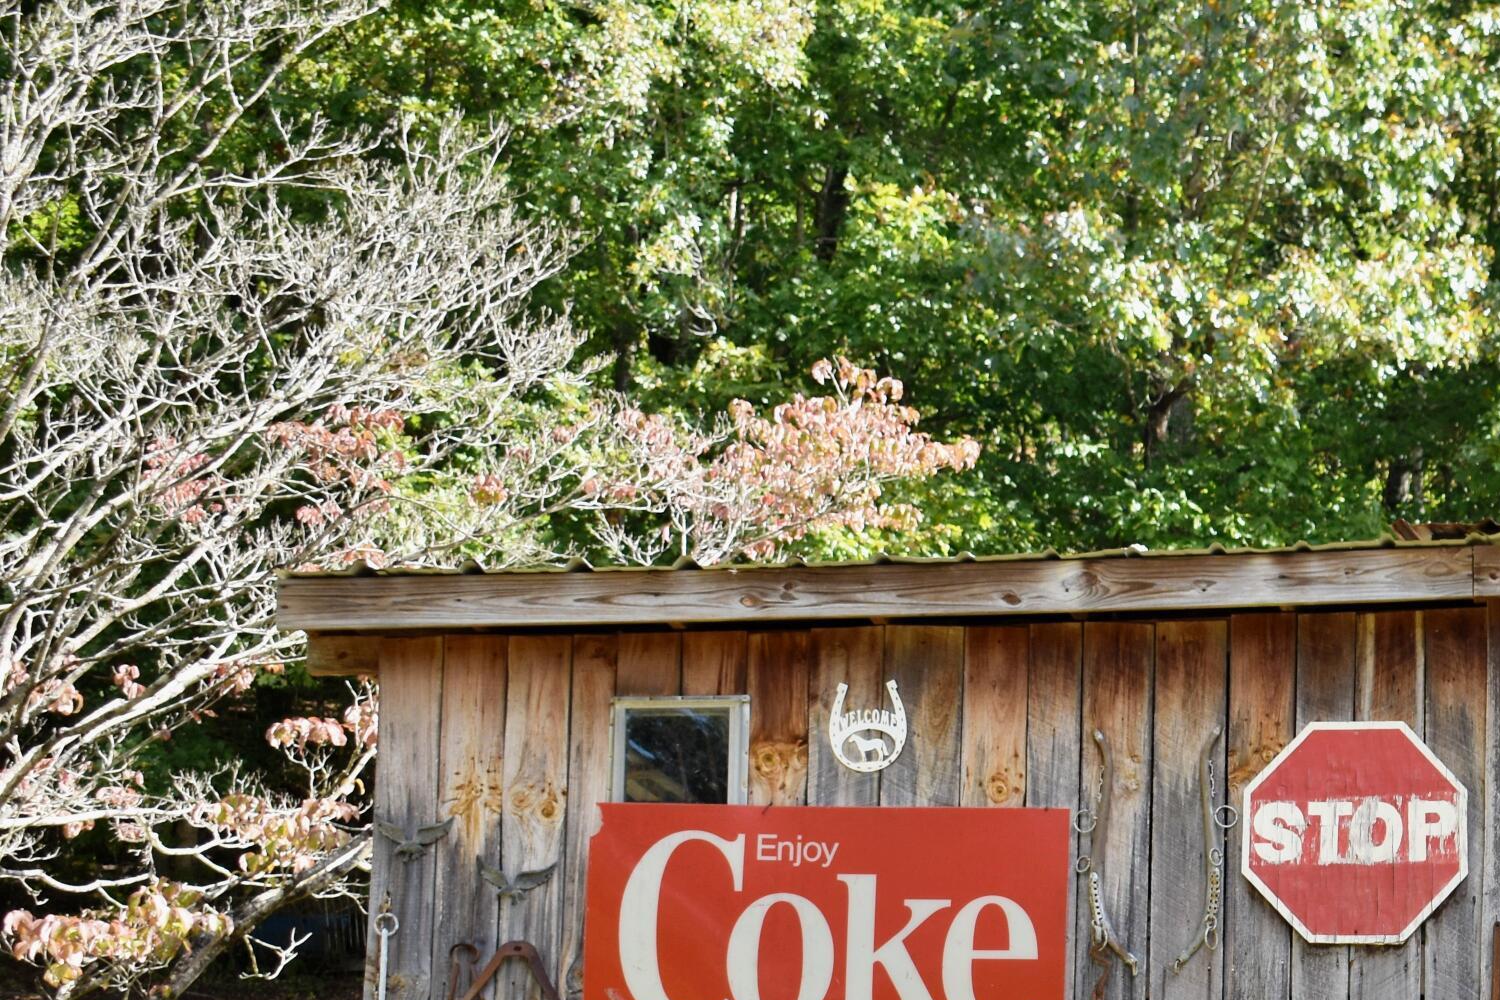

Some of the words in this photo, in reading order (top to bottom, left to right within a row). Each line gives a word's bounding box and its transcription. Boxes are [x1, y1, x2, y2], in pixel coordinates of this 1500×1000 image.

[839, 708, 898, 732] WELCOME
[1252, 799, 1459, 864] STOP
[755, 833, 840, 868] Enjoy
